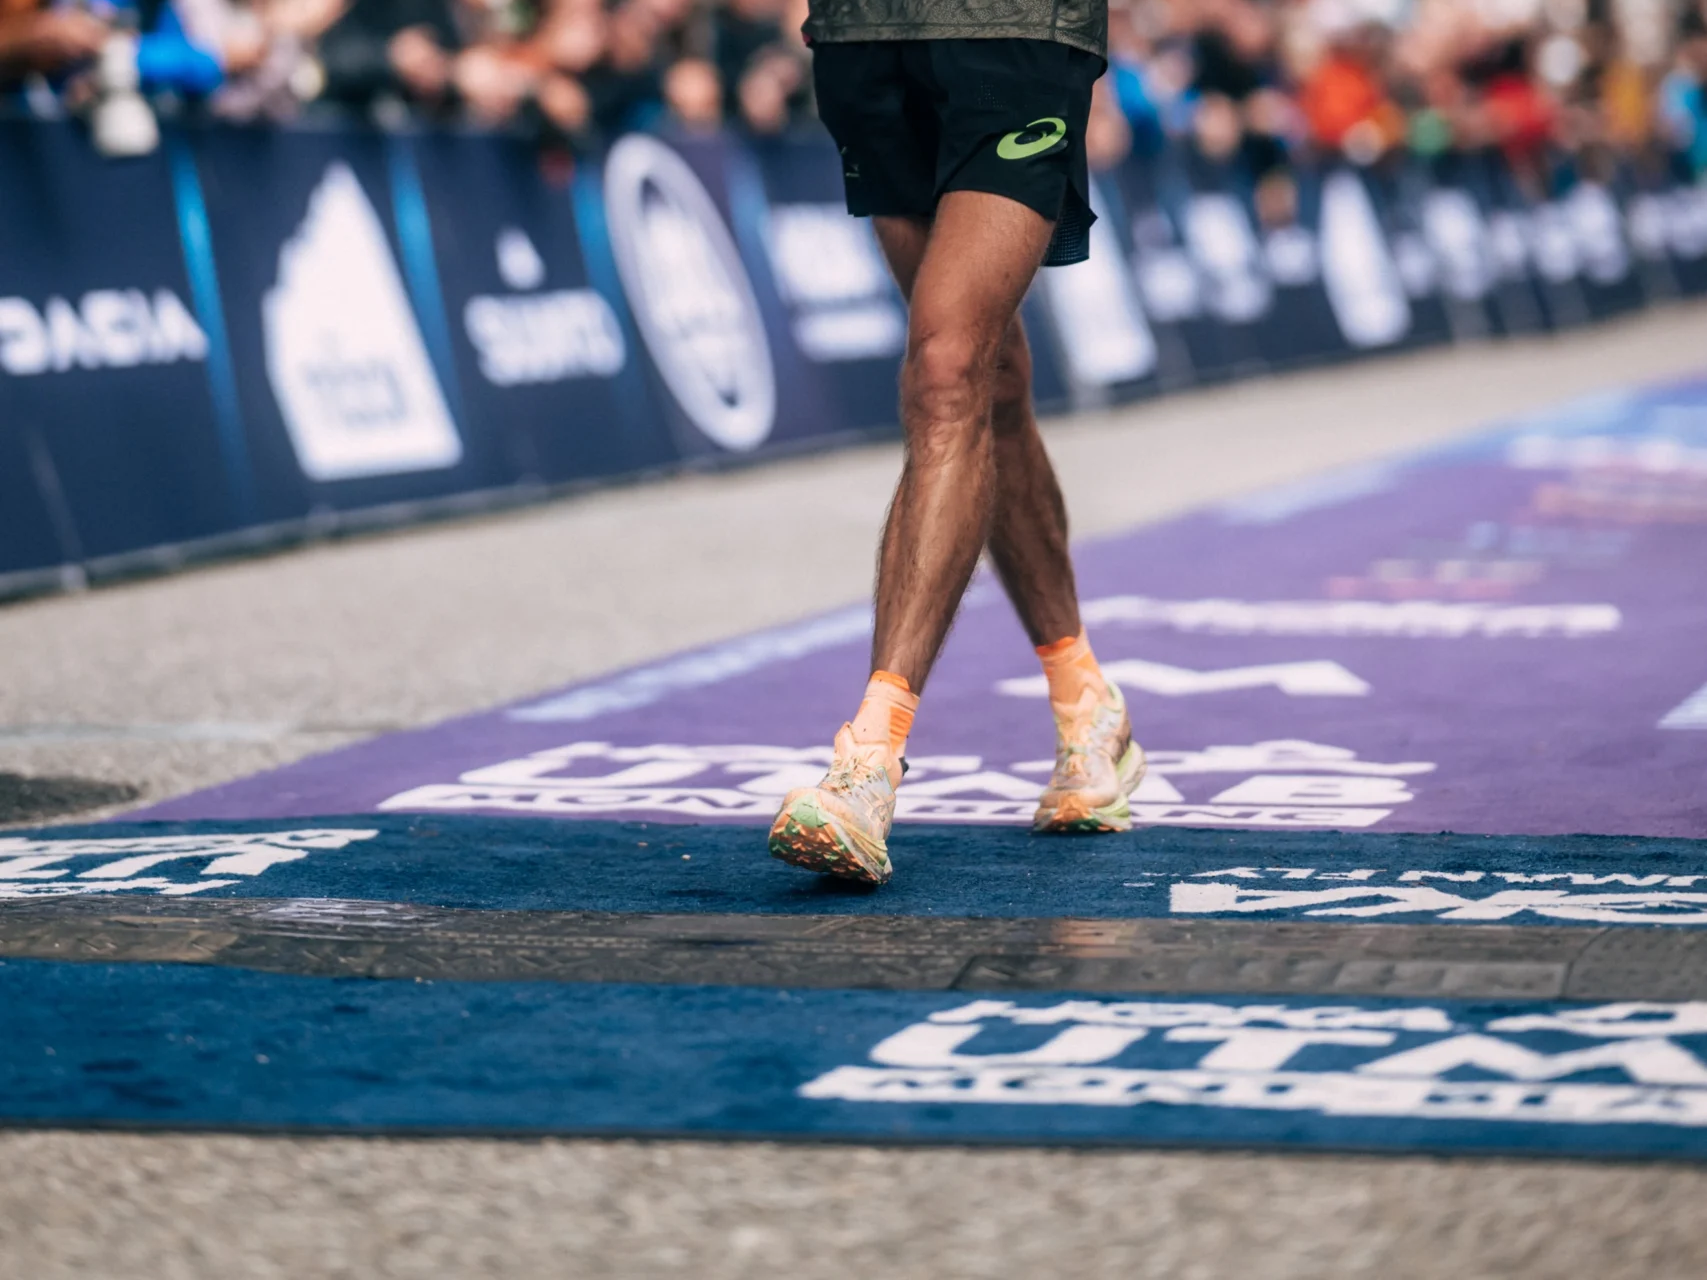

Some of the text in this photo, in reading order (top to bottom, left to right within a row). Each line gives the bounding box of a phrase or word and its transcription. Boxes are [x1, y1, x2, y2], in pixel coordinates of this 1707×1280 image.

[905, 804, 1344, 821] BLNC
[0, 844, 308, 879] UT
[1190, 867, 1387, 881] FLY
[1170, 882, 1707, 923] OKA
[928, 999, 1453, 1032] HOKA
[867, 1021, 1707, 1085] UTM
